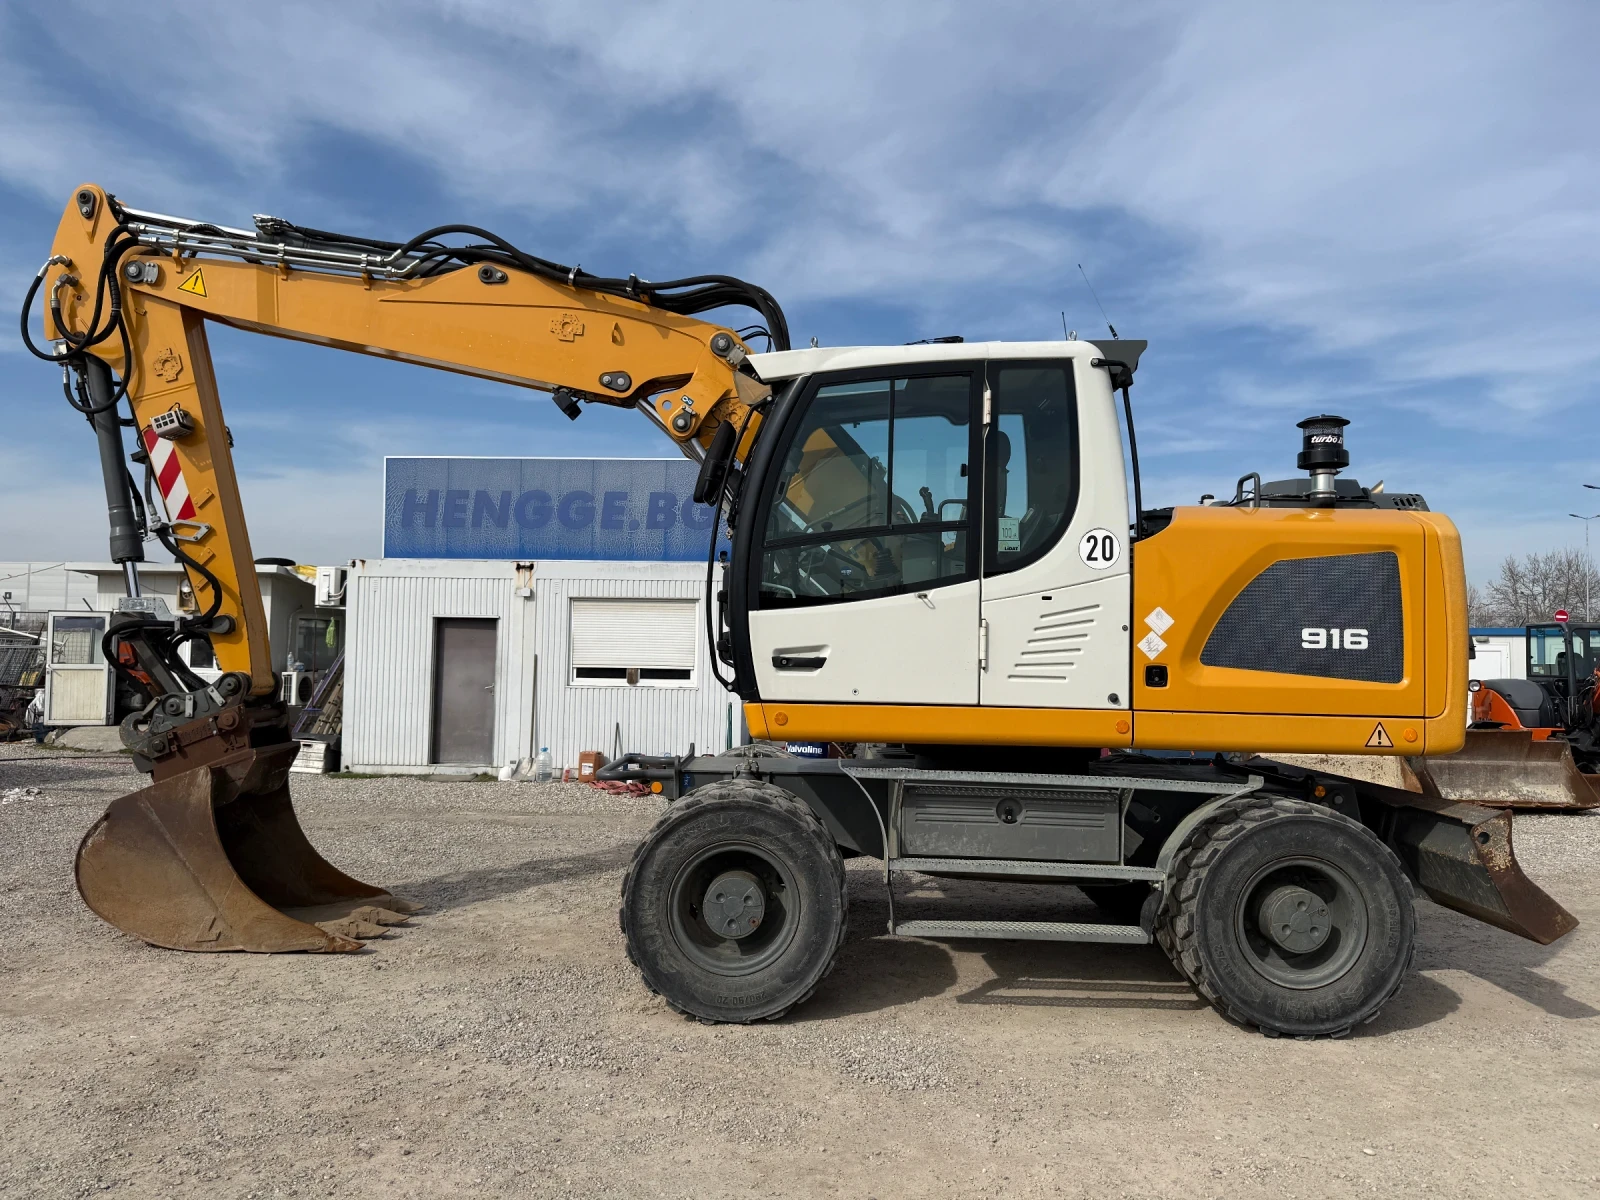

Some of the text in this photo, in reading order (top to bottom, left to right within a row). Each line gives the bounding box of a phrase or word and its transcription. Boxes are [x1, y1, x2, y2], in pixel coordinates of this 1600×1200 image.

[1311, 435, 1338, 443] turbo
[402, 489, 717, 530] HENGGE.BG
[1086, 535, 1114, 562] 20
[1302, 628, 1369, 650] 916
[786, 744, 823, 755] Valvoline
